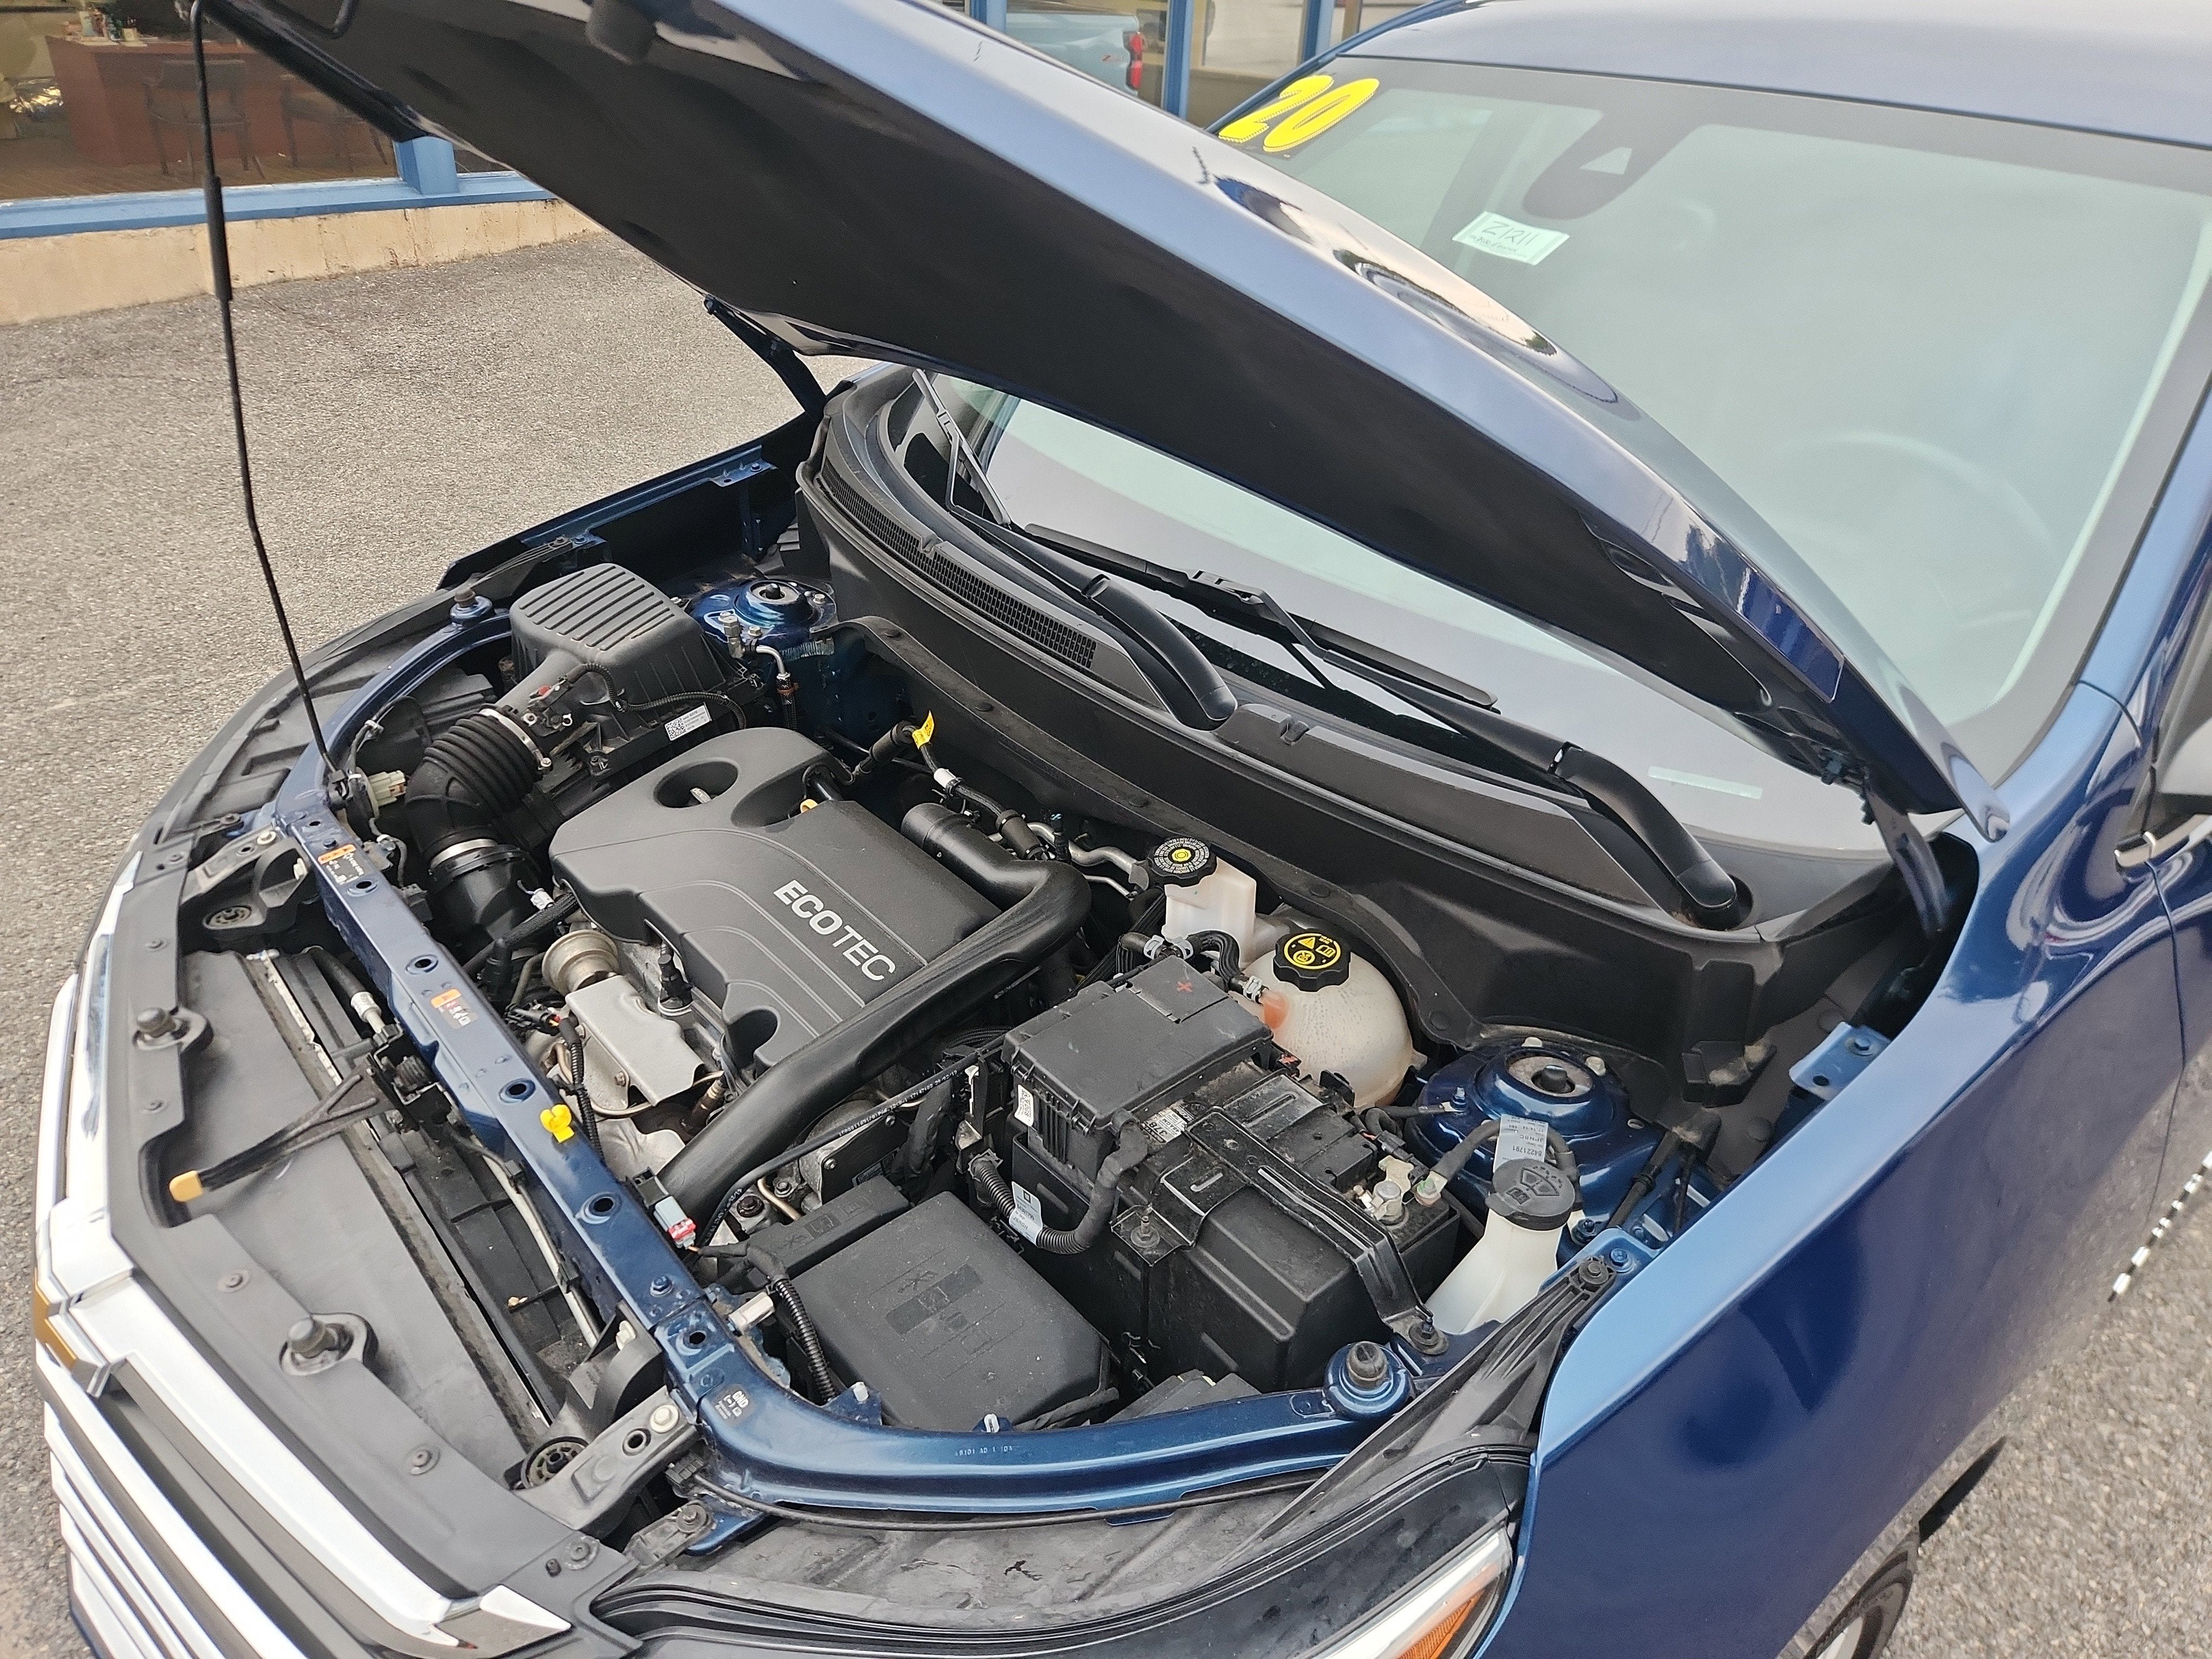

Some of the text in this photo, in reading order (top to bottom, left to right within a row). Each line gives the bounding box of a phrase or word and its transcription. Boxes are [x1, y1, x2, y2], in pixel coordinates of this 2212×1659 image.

[1218, 75, 1380, 152] 20
[773, 879, 896, 981] ECOTEC
[1149, 1122, 1167, 1136] 378
[1512, 1145, 1542, 1156] 84221791
[732, 1390, 749, 1408] GND
